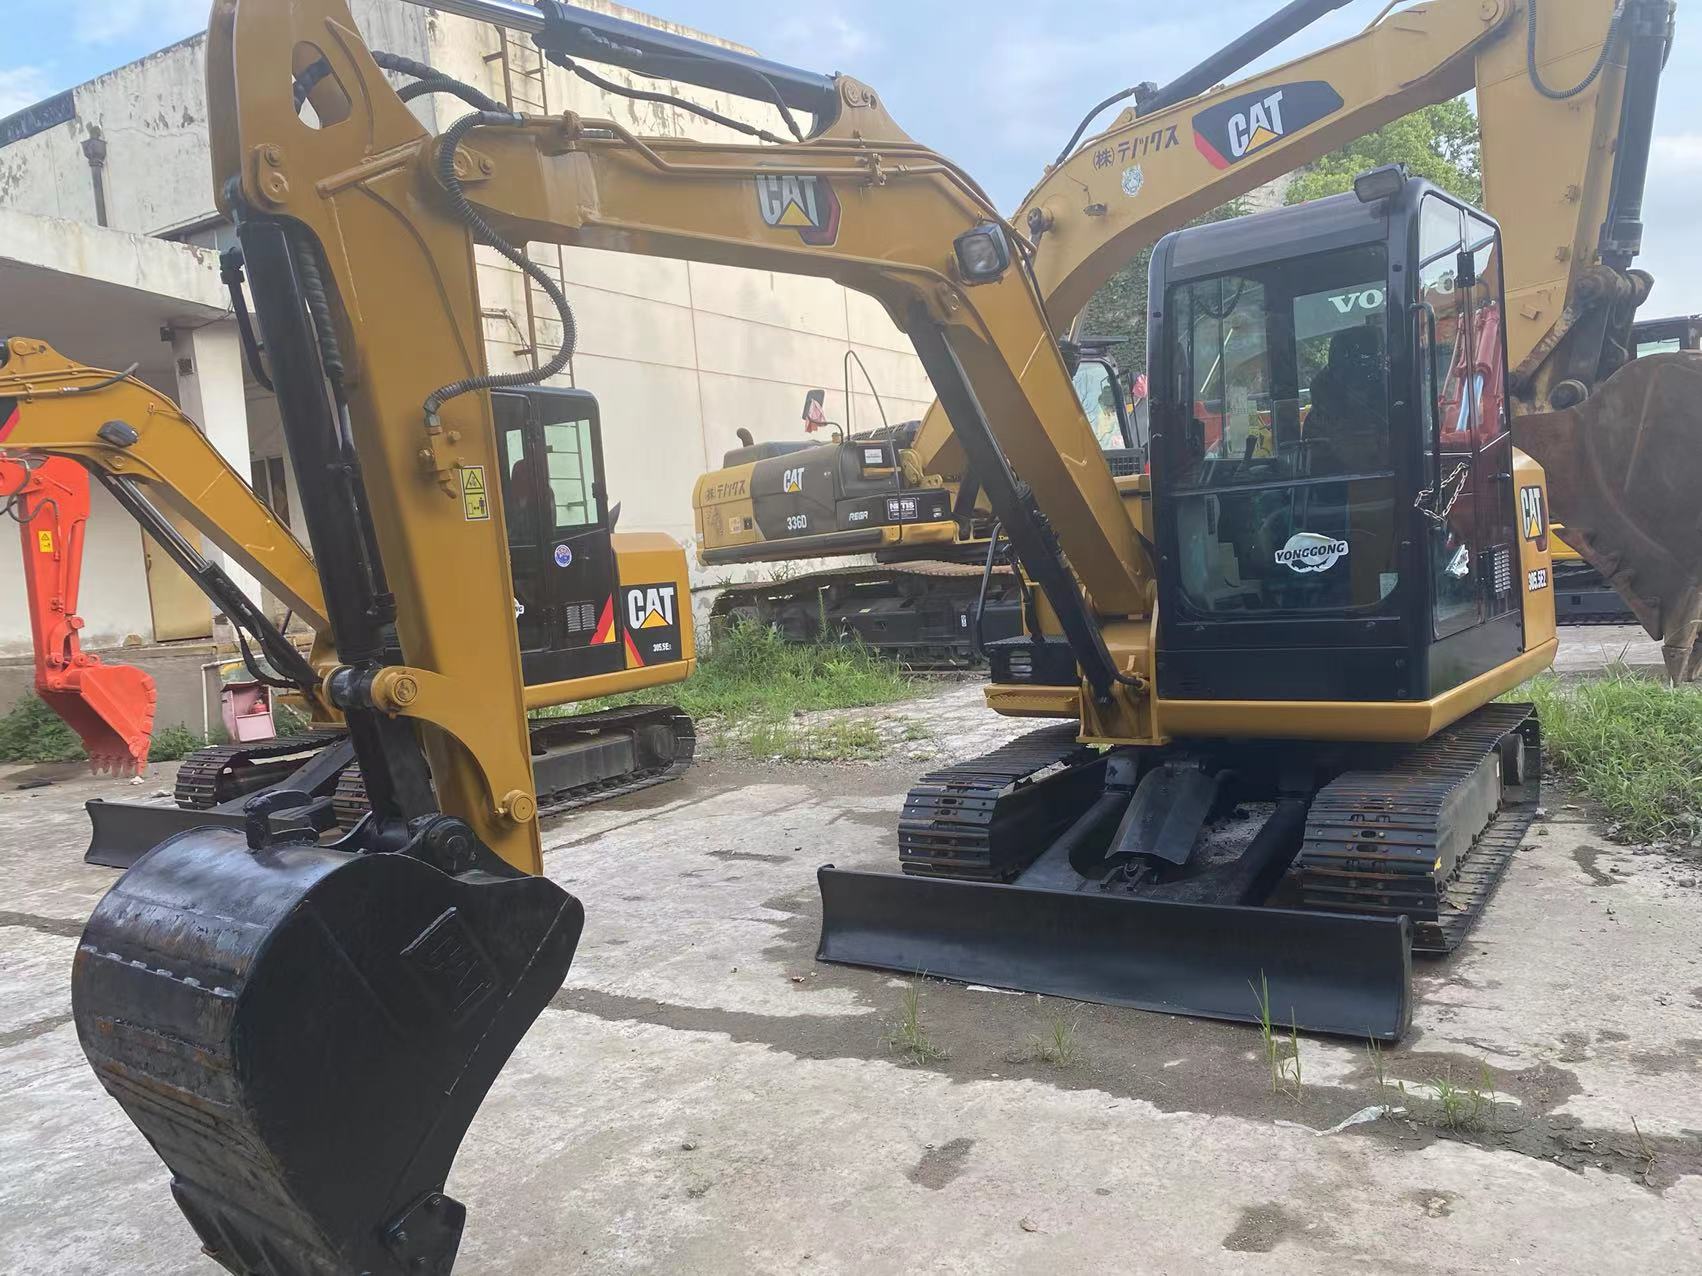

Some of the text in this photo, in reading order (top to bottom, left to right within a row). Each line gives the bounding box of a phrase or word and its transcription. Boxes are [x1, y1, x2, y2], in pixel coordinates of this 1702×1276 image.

[1228, 90, 1284, 157] CAT
[756, 174, 819, 227] CAT
[783, 467, 805, 493] CAT
[786, 514, 807, 530] 336D
[1520, 487, 1542, 539] CAT
[1276, 542, 1346, 563] YONGGONG
[628, 587, 674, 629] CAT
